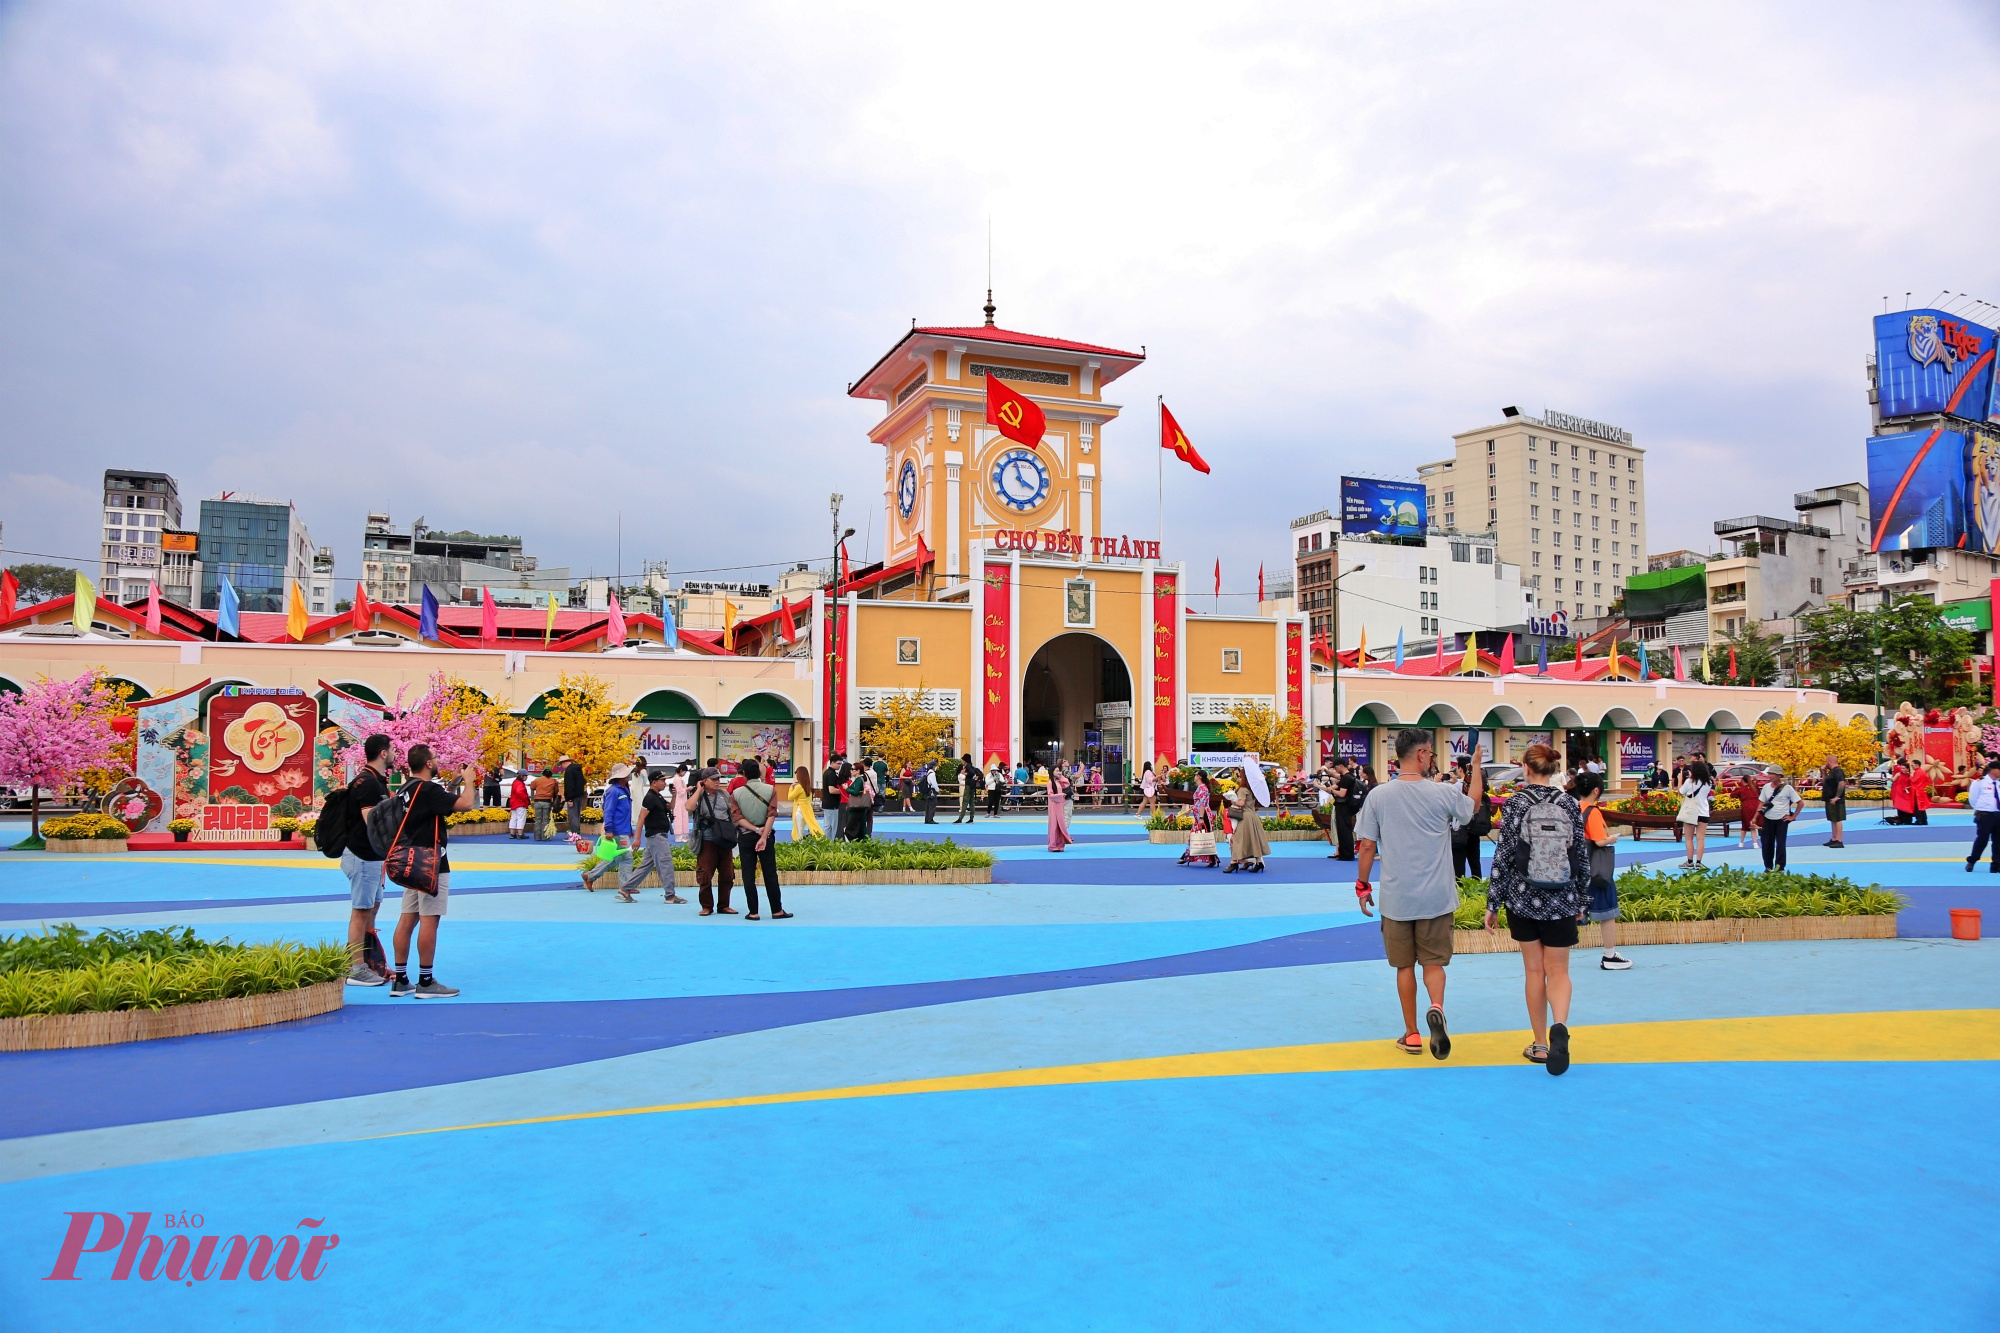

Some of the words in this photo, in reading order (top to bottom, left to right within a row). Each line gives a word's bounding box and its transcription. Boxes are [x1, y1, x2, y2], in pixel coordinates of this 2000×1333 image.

[1940, 319, 1981, 361] Tiger
[994, 529, 1038, 553] CHỢ
[1044, 528, 1084, 554] BẾN
[1090, 534, 1160, 559] THÀNH
[685, 581, 699, 589] BỆNH
[701, 582, 712, 590] VIỆN
[740, 583, 758, 592] Á-ÂU
[241, 687, 276, 696] KHANG
[278, 685, 302, 696] ĐIỀN
[244, 719, 287, 760] Tết
[1620, 737, 1641, 754] Vikki
[1720, 738, 1739, 754] Vikki
[1227, 753, 1242, 762] ĐIỀN
[204, 806, 268, 830] 2026
